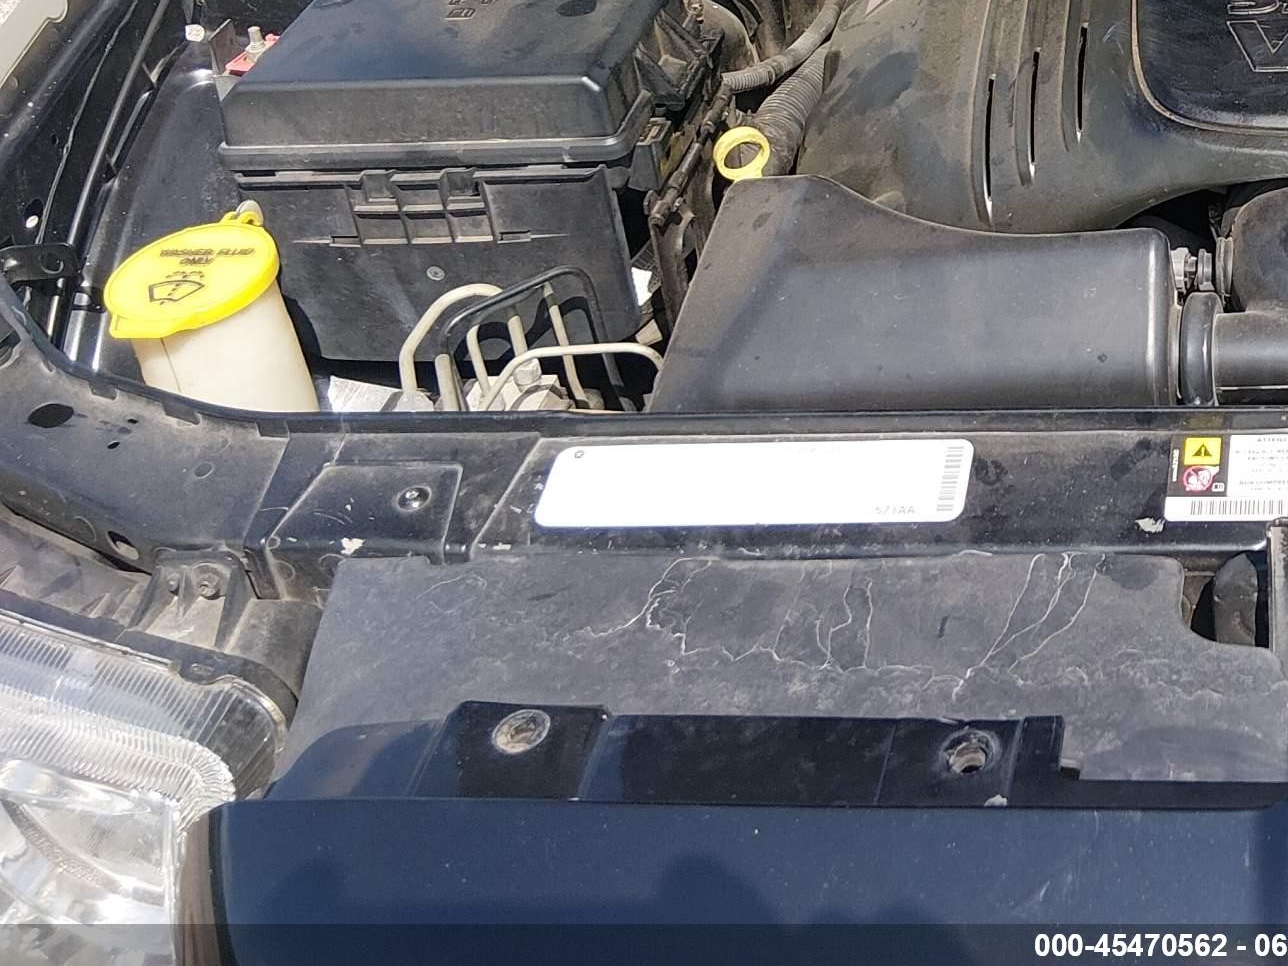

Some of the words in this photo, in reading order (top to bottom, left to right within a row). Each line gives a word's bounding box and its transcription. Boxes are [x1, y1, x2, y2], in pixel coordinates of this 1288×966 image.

[160, 248, 214, 257] WASHER
[216, 247, 256, 256] FLUID
[179, 256, 215, 265] ONLY
